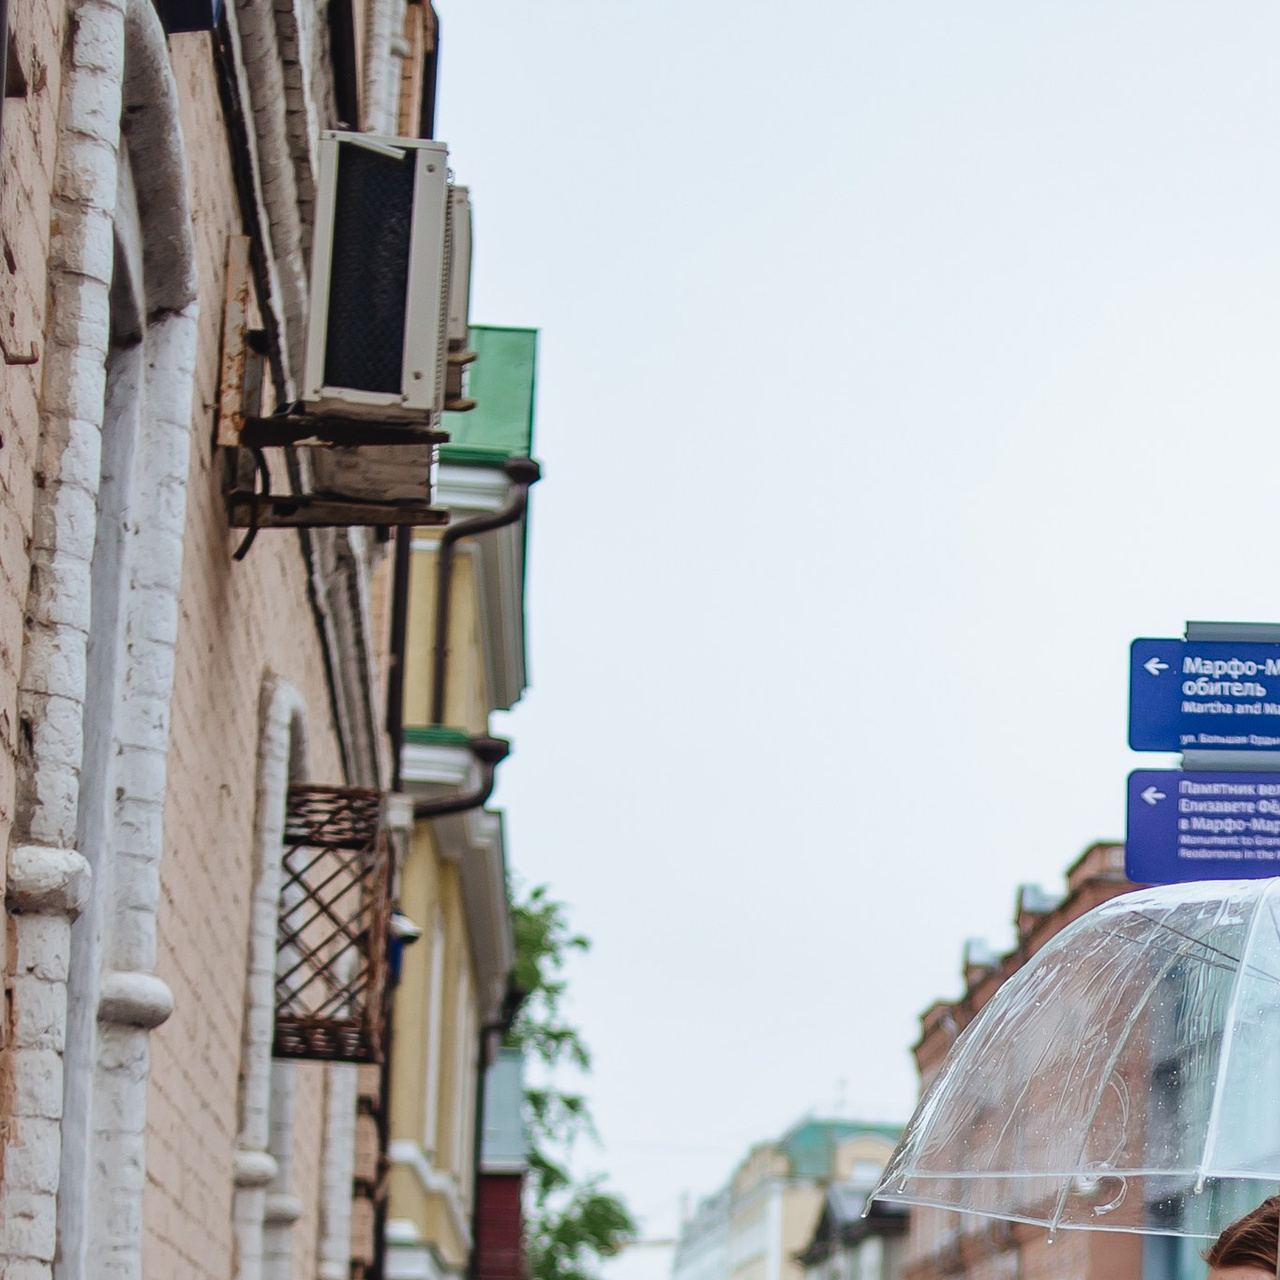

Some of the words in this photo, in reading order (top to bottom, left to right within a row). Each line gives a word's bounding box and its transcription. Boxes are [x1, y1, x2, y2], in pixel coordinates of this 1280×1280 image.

[1182, 677, 1267, 697] обитель
[1181, 701, 1233, 714] Martha
[1234, 702, 1262, 715] and
[1180, 734, 1198, 746] ул.
[1198, 733, 1248, 744] Большая
[1179, 780, 1256, 795] Памятник
[1179, 798, 1255, 814] Елизавете
[1179, 818, 1189, 830] в
[1179, 835, 1239, 846] Monument
[1240, 836, 1254, 846] to
[1243, 849, 1256, 860] in
[1256, 849, 1275, 860] the
